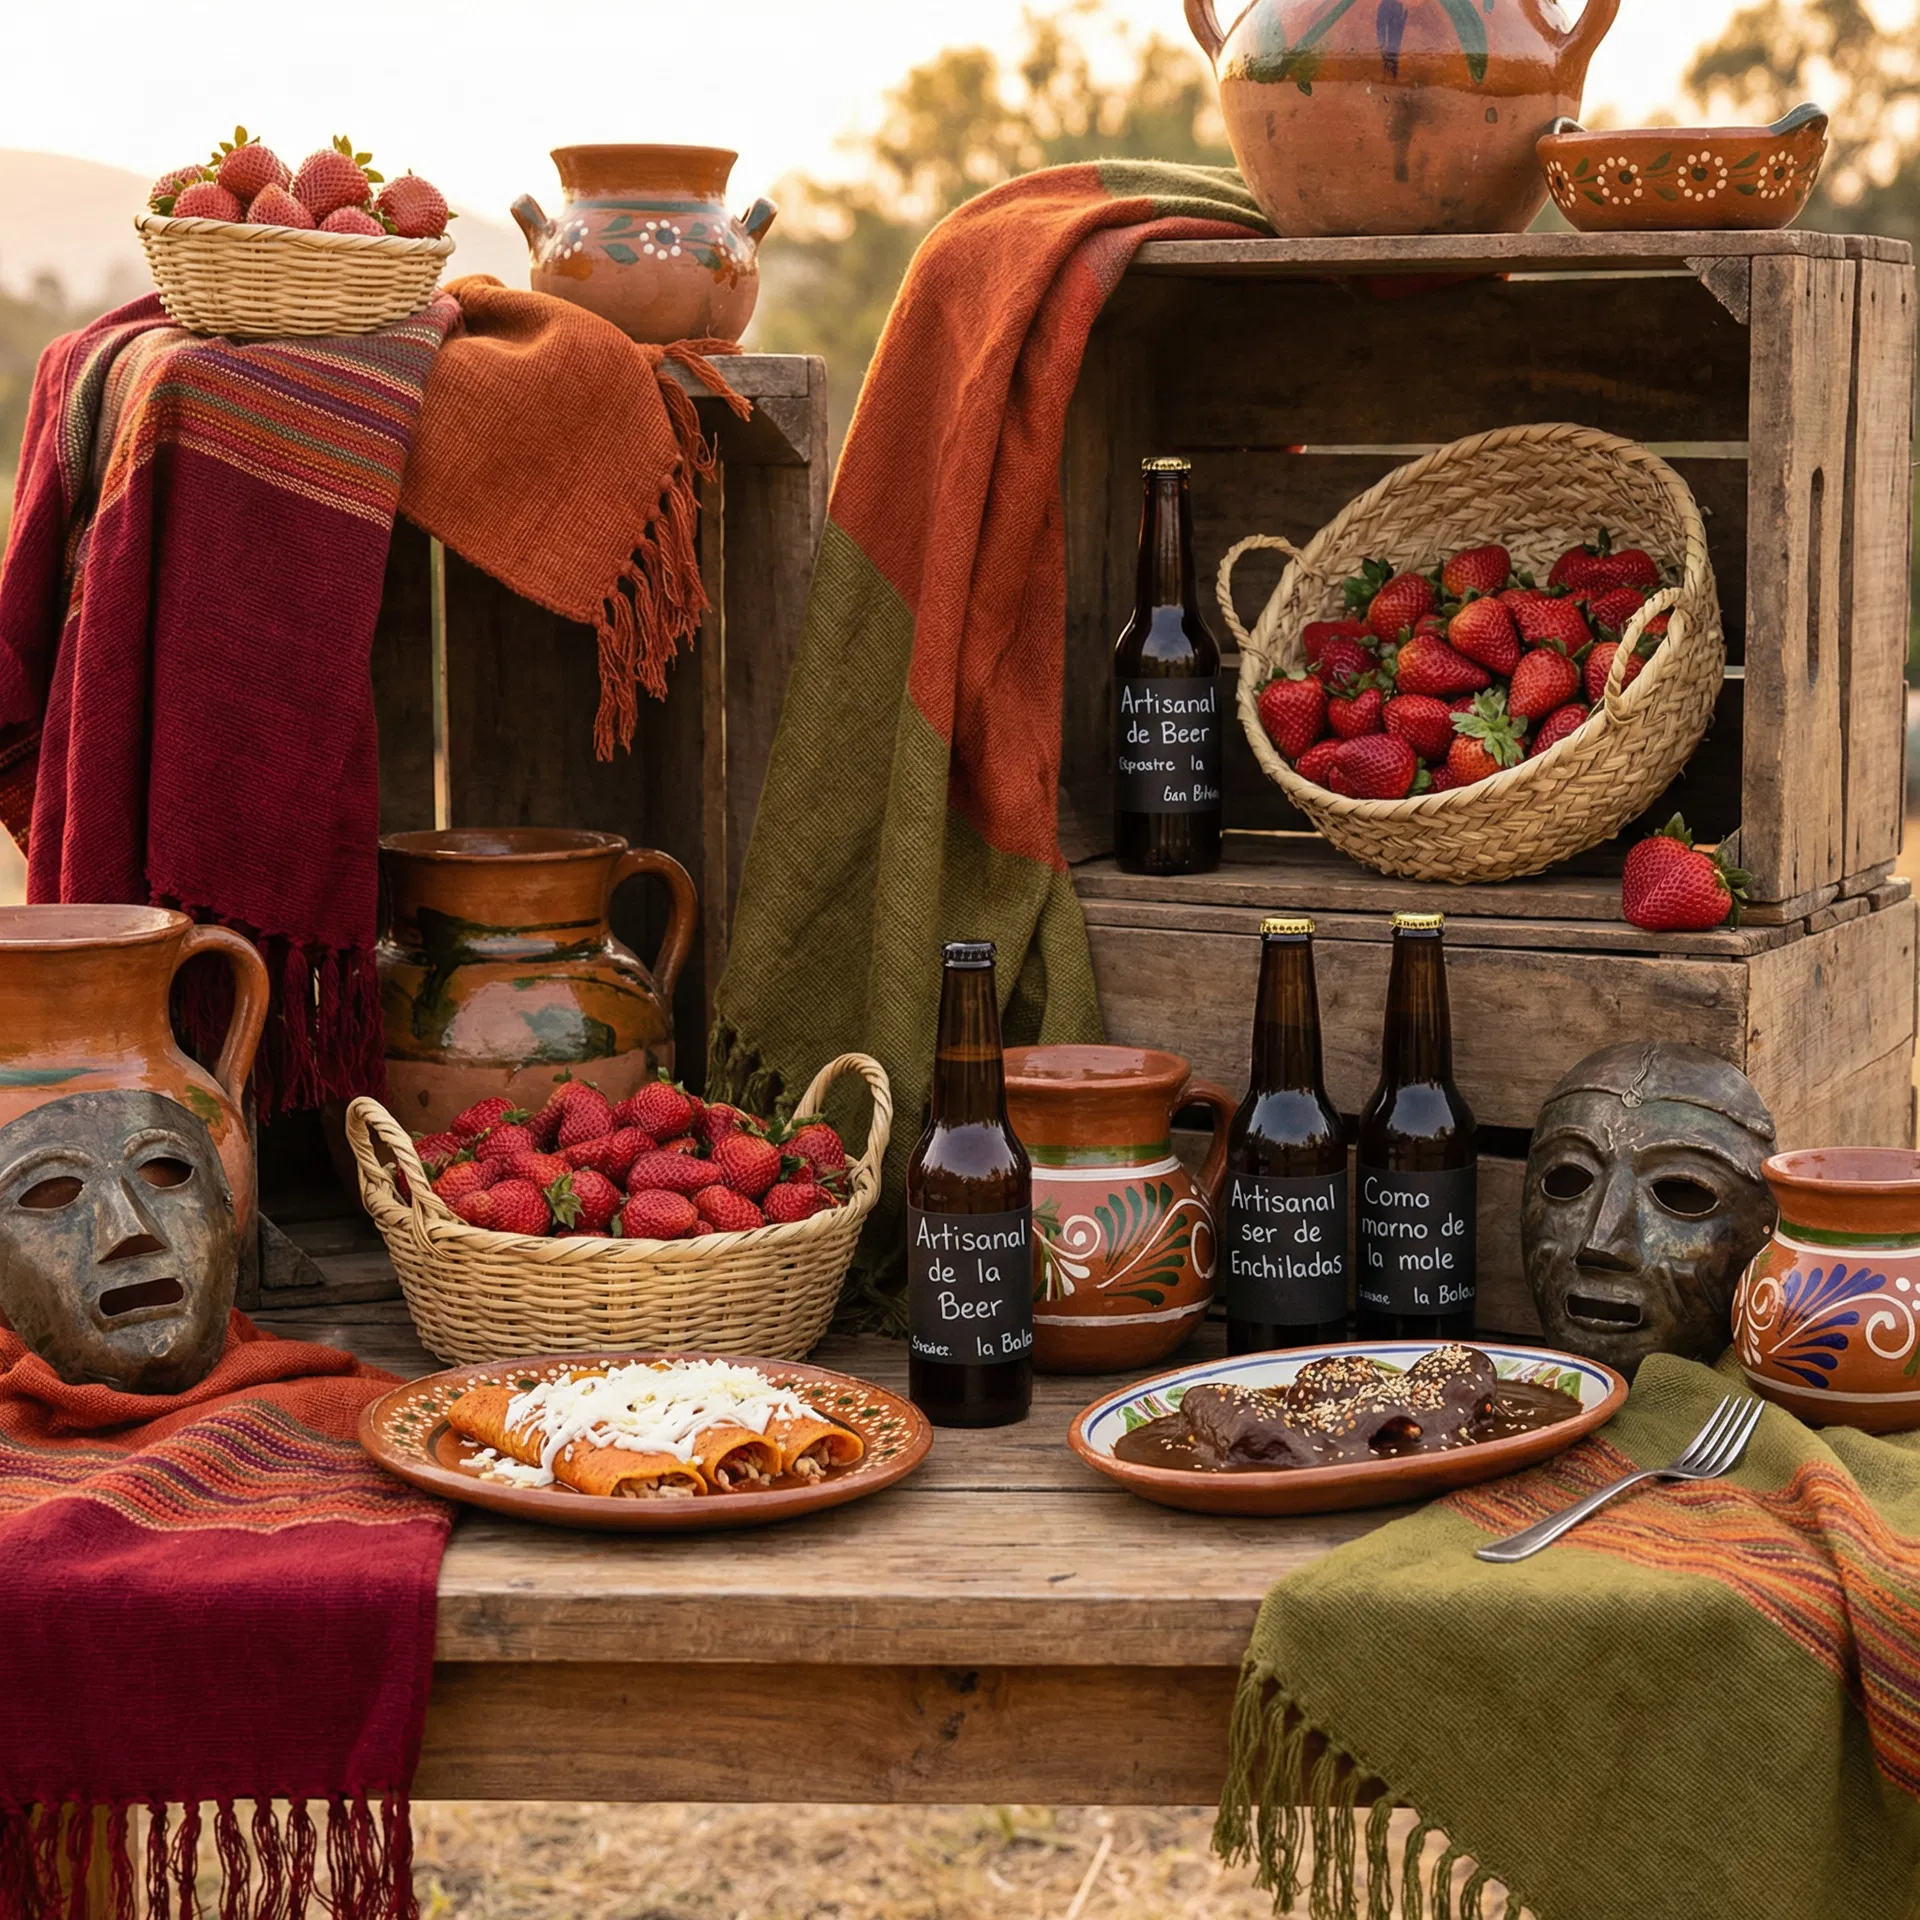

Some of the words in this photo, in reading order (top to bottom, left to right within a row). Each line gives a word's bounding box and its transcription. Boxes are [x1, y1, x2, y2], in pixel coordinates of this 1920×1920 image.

[1120, 685, 1216, 714] Artisanal
[1126, 720, 1151, 744] de
[1160, 721, 1210, 745] Beer
[1190, 754, 1204, 771] la
[1231, 1179, 1336, 1213] Artisanal
[916, 1216, 1026, 1252] Artisanal
[1241, 1223, 1278, 1243] ser
[1293, 1218, 1323, 1244] de
[1441, 1212, 1465, 1237] de
[1231, 1250, 1343, 1279] Enchiladas
[1368, 1242, 1384, 1268] la
[1399, 1246, 1455, 1271] mole
[928, 1257, 957, 1284] de
[977, 1258, 1001, 1284] la
[937, 1291, 1003, 1320] Beer
[1414, 1286, 1431, 1305] la
[976, 1336, 995, 1357] la
